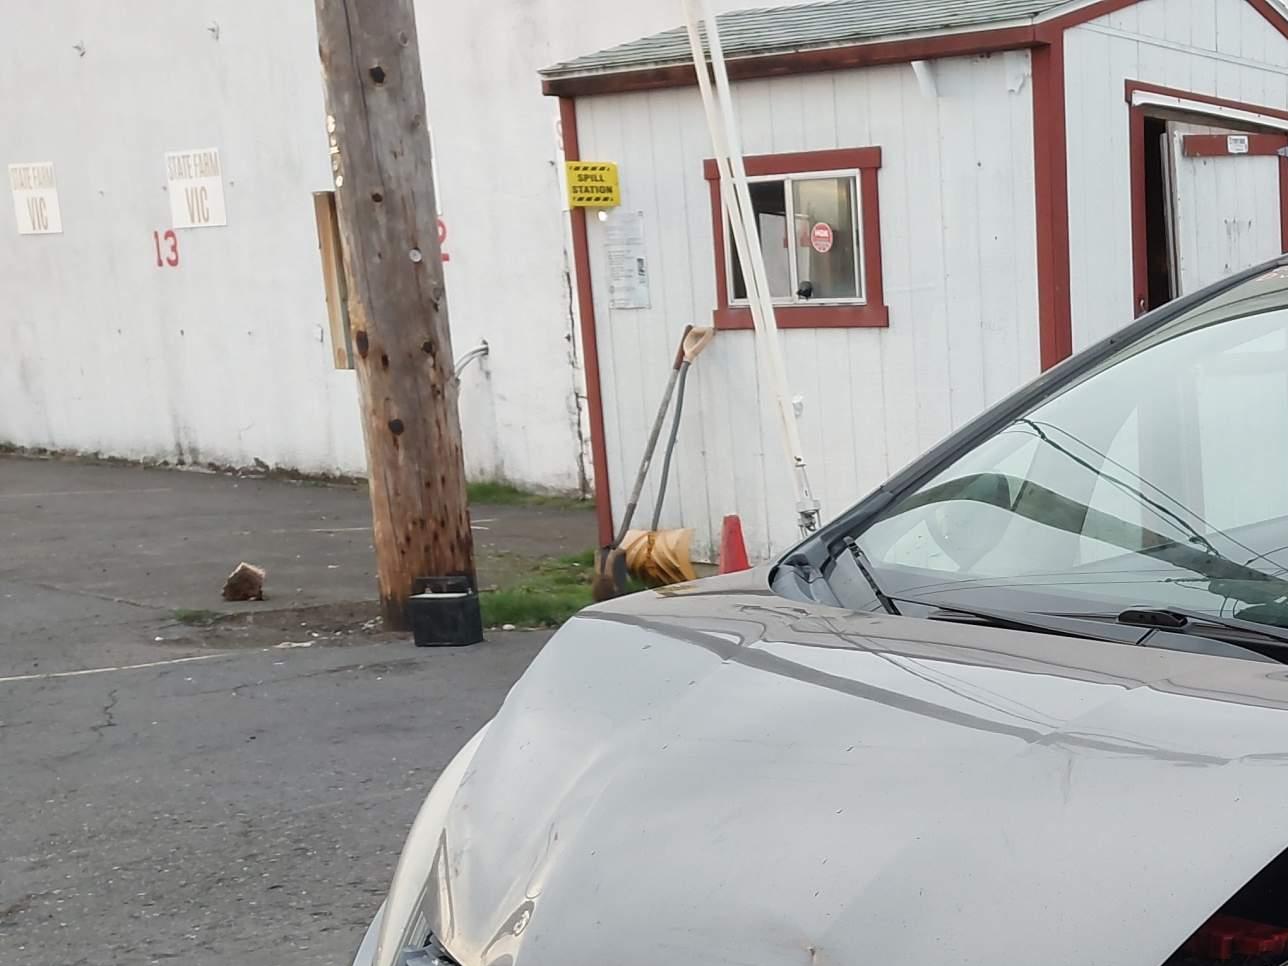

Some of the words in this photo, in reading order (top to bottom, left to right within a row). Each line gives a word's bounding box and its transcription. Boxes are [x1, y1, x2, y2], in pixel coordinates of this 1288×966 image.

[168, 154, 192, 180] STATE
[577, 173, 604, 182] SPILL
[572, 185, 613, 194] STATION
[27, 197, 48, 230] VIC
[185, 186, 210, 223] VIC
[154, 230, 179, 267] 13
